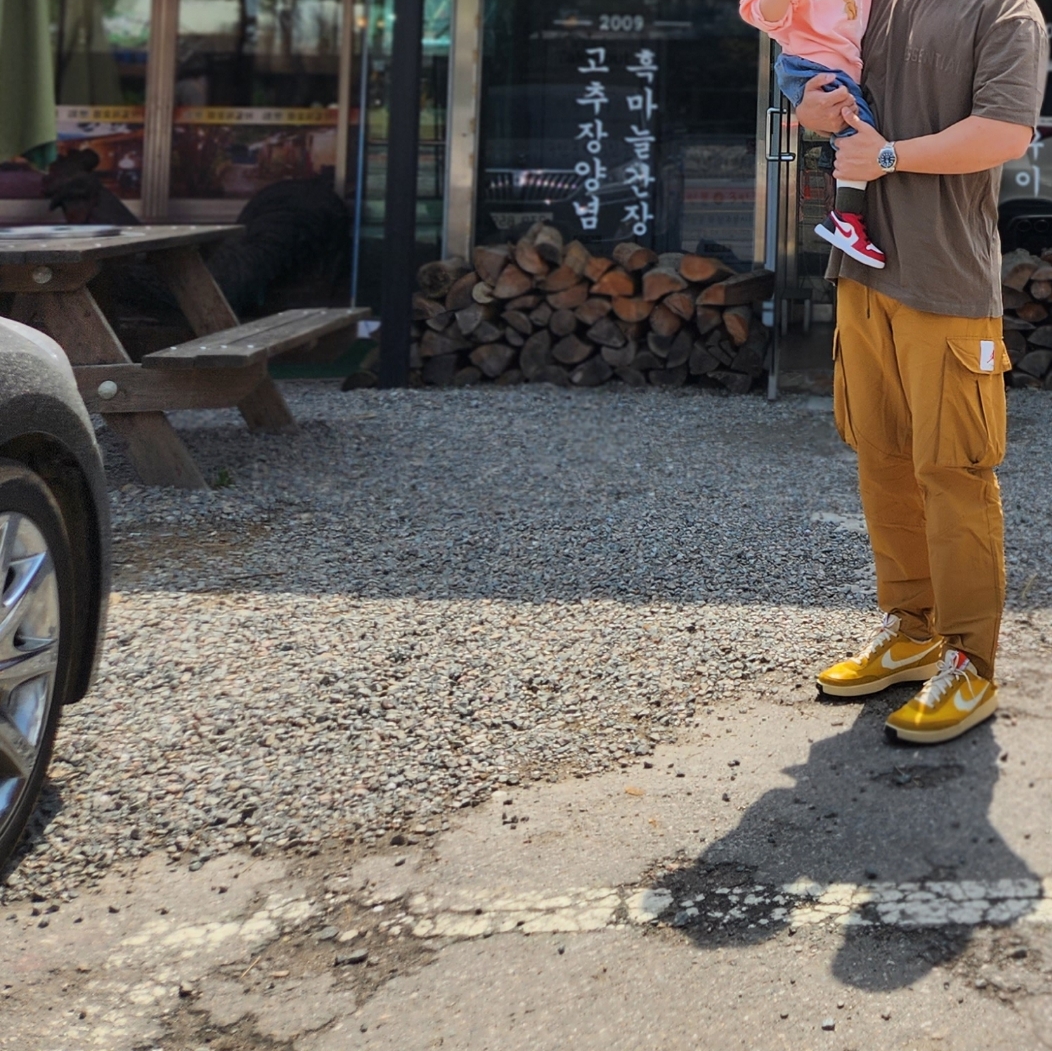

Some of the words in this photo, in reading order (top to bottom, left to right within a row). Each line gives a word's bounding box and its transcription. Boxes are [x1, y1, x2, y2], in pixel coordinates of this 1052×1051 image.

[599, 14, 645, 32] 2009
[572, 47, 610, 230] 고추장양념
[620, 49, 659, 236] 흑마늘간장
